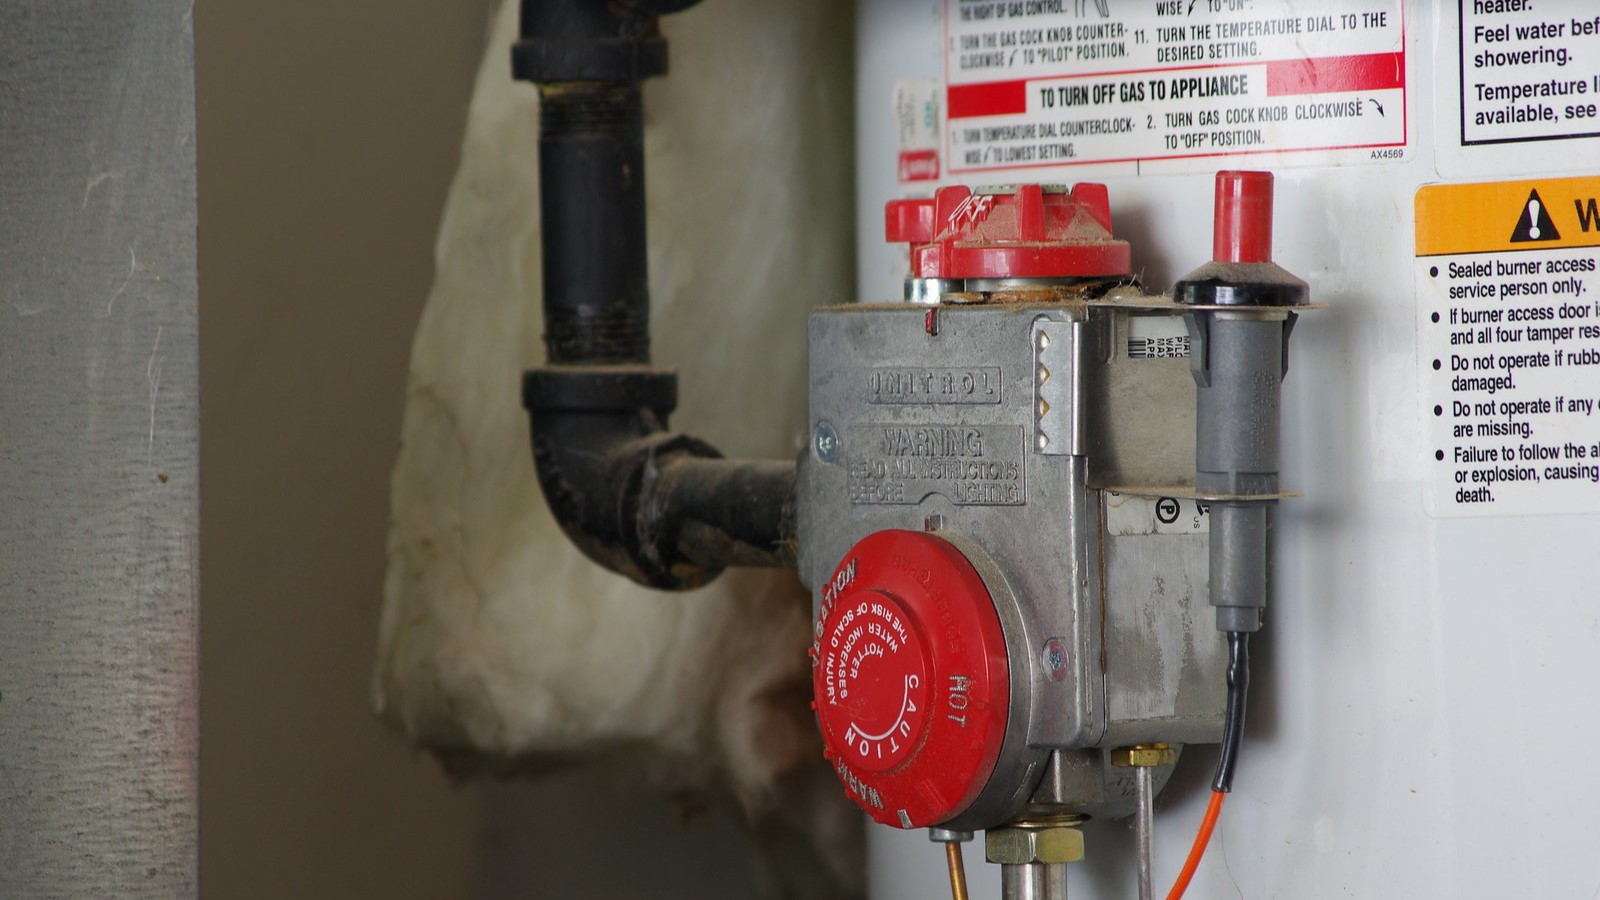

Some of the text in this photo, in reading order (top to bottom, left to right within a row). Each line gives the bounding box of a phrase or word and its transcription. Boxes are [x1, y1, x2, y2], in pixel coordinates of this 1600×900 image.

[1008, 1, 1023, 17] GAS
[1026, 0, 1068, 15] CONTROL.
[1156, 1, 1182, 16] WISE
[1208, 0, 1221, 12] TO
[1474, 0, 1533, 14] heater.
[960, 34, 980, 50] TURN
[982, 33, 997, 48] THE
[1000, 31, 1016, 46] GAS
[1020, 30, 1043, 45] COCK
[1048, 27, 1072, 43] KNOB
[1076, 22, 1128, 40] COUNTER-
[1134, 12, 1387, 44] 11. TURN THE TEMPERATURE DIAL TO THE
[1474, 24, 1510, 44] Feel
[1516, 22, 1565, 40] water
[960, 42, 1129, 70] CLOCKWISE TO "PILOT" POSITION.
[1157, 40, 1262, 63] DESIRED SETTING.
[1474, 46, 1572, 68] showering.
[1040, 74, 1248, 108] TO TURN OFF GAS TO APPLIANCE
[1475, 79, 1588, 103] Temperature
[1146, 101, 1363, 130] 2. TURN GAS COCK KNOB CLOCKWISE
[1476, 104, 1597, 126] available, see
[964, 128, 981, 144] TURN
[984, 124, 1036, 143] TEMPERATURE
[1039, 122, 1056, 138] DIAL
[1060, 118, 1136, 137] COUNTERCLOCK-
[1165, 130, 1265, 150] TO "OFF" POSITION.
[965, 142, 1077, 164] WISE TO LOWEST SETTING.
[1370, 150, 1404, 160] AX4569
[948, 195, 993, 223] OFF
[1448, 258, 1596, 279] Sealed burner access
[1450, 276, 1586, 300] service person only.
[1450, 308, 1457, 324] If
[1462, 308, 1504, 324] burner
[1508, 306, 1554, 322] access
[1558, 302, 1590, 319] door
[1450, 328, 1474, 345] and
[1478, 327, 1492, 343] all
[1496, 326, 1523, 342] four
[1527, 326, 1574, 344] tamper
[1452, 349, 1600, 373] Do not operate if rubb
[869, 372, 994, 395] UNITROL
[1452, 373, 1516, 394] damaged.
[1453, 396, 1593, 419] Do not operate if any
[1454, 420, 1534, 439] are missing.
[883, 429, 984, 458] WARNING
[1454, 446, 1498, 463] Failure
[1502, 446, 1515, 461] to
[1519, 444, 1560, 460] follow
[1564, 442, 1586, 459] the
[850, 458, 1020, 480] READ ALL INSTRUCTIONS
[1455, 463, 1599, 486] or explosion, causing
[850, 482, 904, 502] BEFORE
[954, 481, 1020, 503] LIGHTING
[1456, 486, 1495, 503] death.
[826, 602, 908, 706] THE RISK OF SCALD INJURY
[838, 622, 898, 699] WATER INCREASES
[850, 642, 884, 680] HOTTER
[948, 674, 968, 728] HOT
[845, 674, 919, 759] CAUTION
